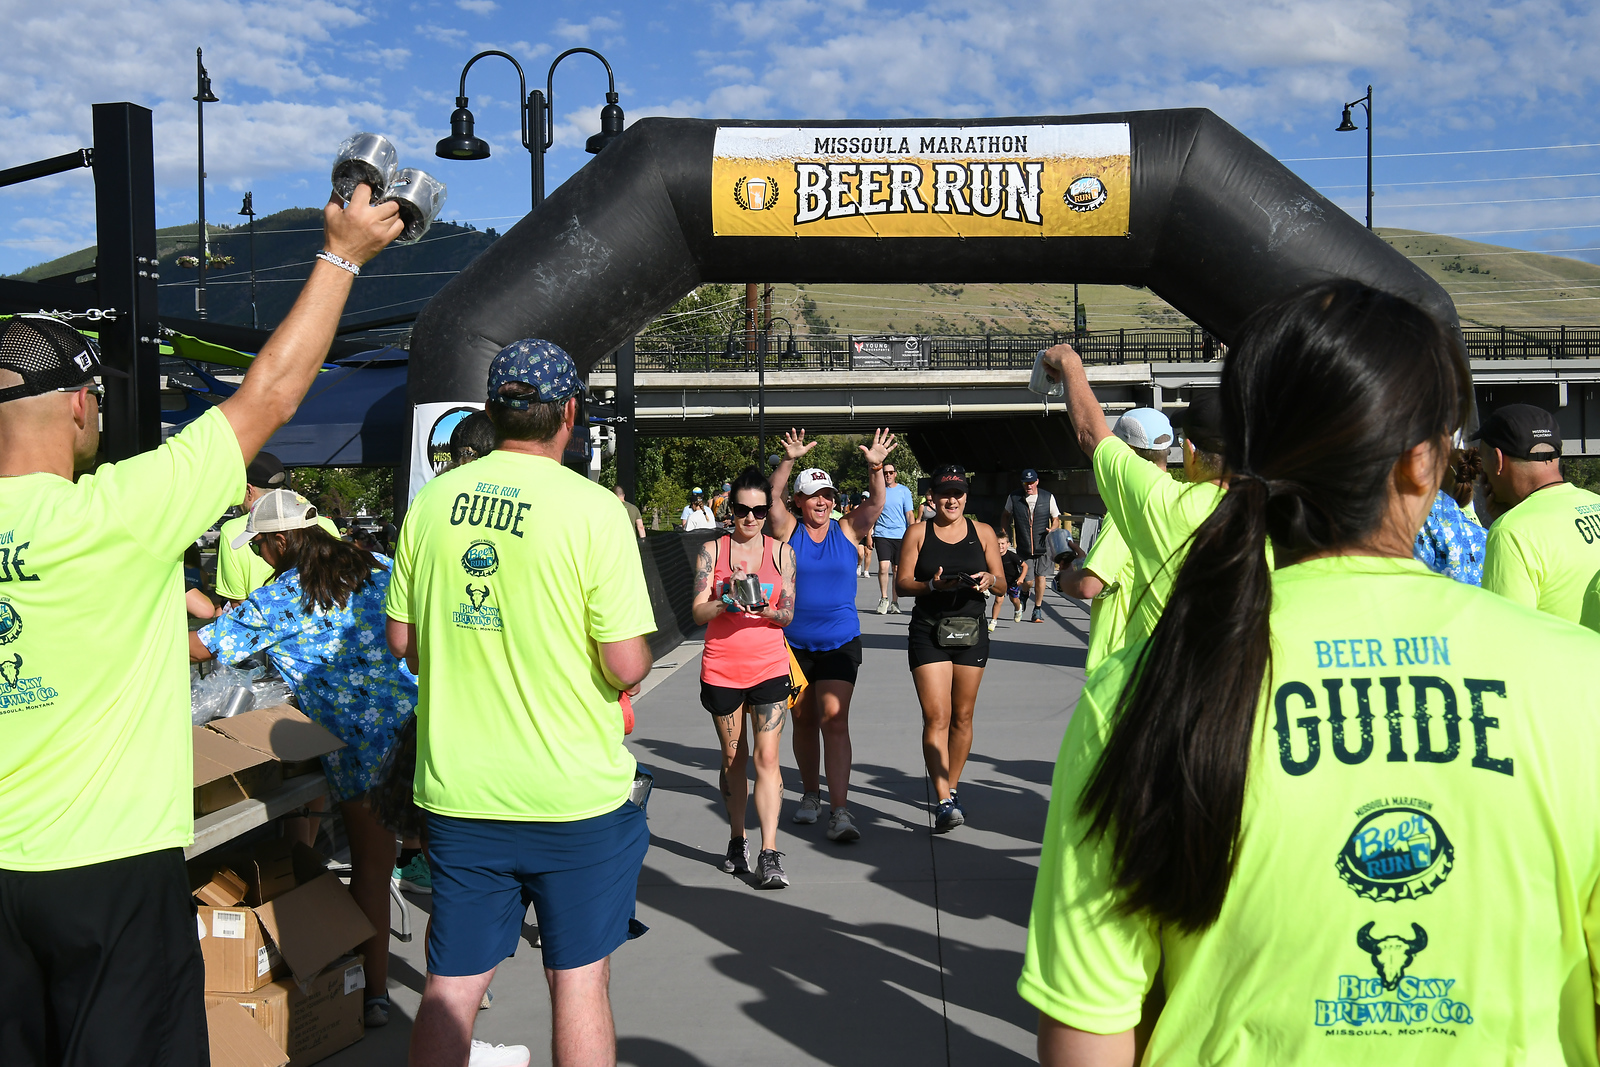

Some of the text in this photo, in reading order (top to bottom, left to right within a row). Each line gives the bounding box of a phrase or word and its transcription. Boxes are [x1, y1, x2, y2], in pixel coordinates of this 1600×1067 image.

[814, 135, 1028, 154] MISSOULA MARATHON
[794, 162, 1045, 226] BEER RUN
[1074, 193, 1091, 202] RUN
[433, 452, 452, 462] MISS
[475, 482, 521, 498] BEER RUN
[450, 493, 532, 538] GUIDE
[460, 603, 475, 614] BIG
[453, 611, 491, 626] BREWING
[1314, 635, 1452, 668] BEER RUN
[16, 677, 42, 693] SKY
[36, 687, 58, 702] CO.
[25, 701, 55, 711] MONTANA
[1273, 675, 1514, 777] GUIDE
[1354, 796, 1434, 818] MISSOULA MARATHON
[1352, 814, 1429, 862] Beer
[1366, 854, 1412, 877] RUN
[1337, 975, 1456, 1002] BIG SKY
[1315, 998, 1474, 1027] BREWING CO.
[1325, 1026, 1457, 1037] MISSOULA, MONTANA
